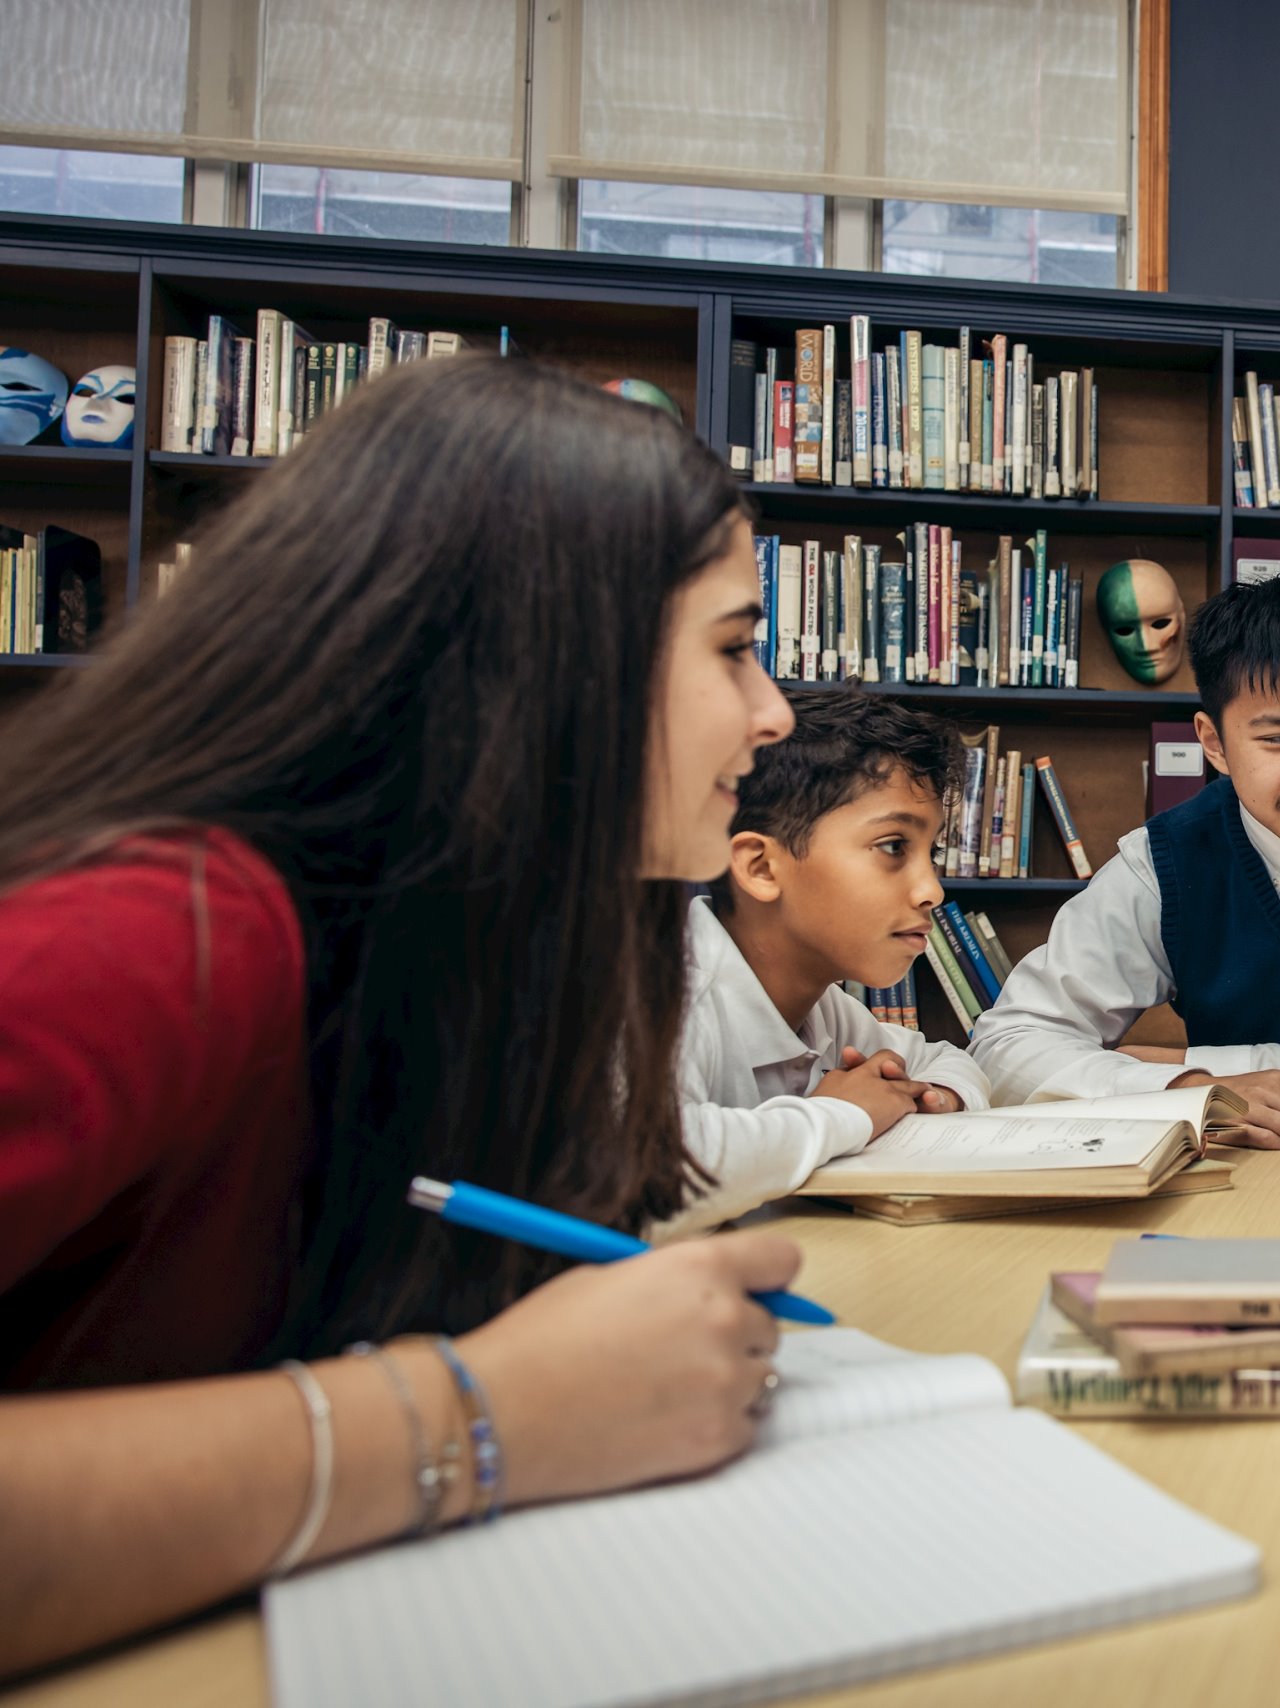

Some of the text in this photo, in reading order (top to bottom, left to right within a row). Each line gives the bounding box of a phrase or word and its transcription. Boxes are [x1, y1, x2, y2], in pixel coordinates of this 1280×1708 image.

[799, 333, 814, 382] WORLD
[909, 336, 920, 431] MYSTERIES DEEP
[918, 550, 928, 650] NORTHWEST PASSAG
[940, 920, 962, 954] ESCORIAL
[951, 910, 980, 960] THE KREMLIN
[1240, 1301, 1271, 1317] THE
